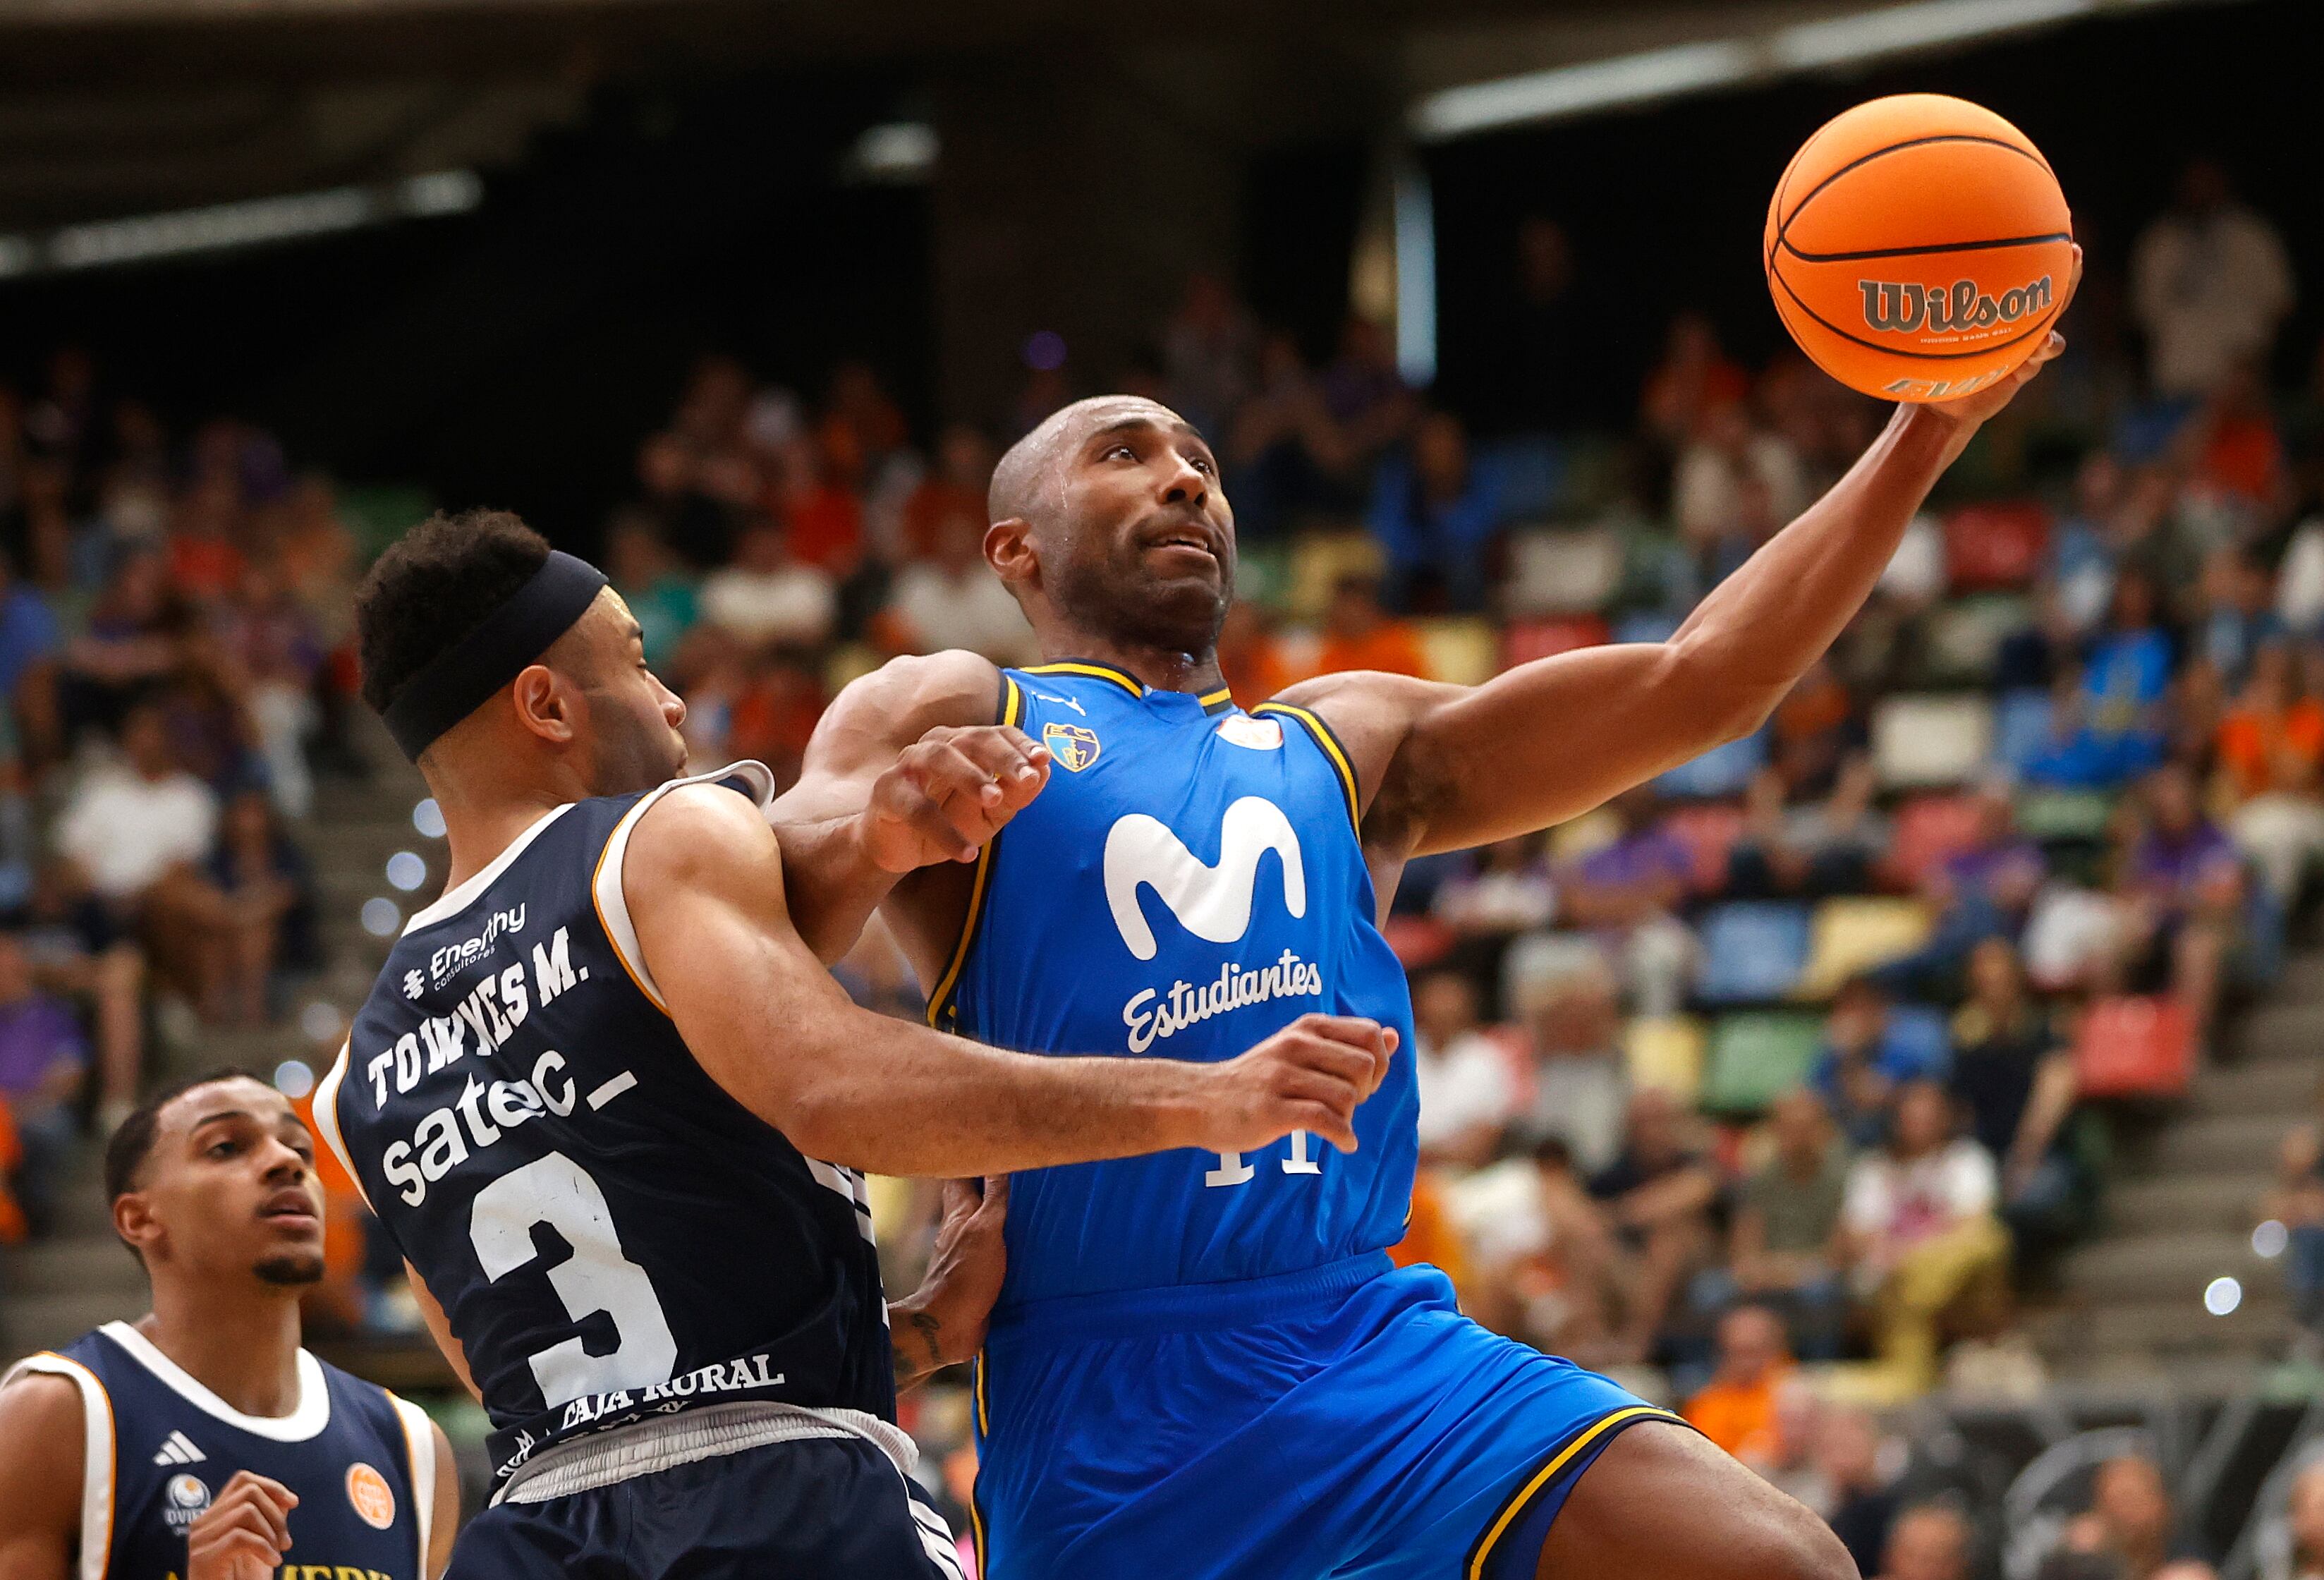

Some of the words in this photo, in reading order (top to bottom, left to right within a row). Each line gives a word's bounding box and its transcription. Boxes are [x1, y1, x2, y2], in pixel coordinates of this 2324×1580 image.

[1858, 275, 2052, 333] Wilson
[430, 902, 525, 980] Enerthy
[434, 944, 496, 992] consultores
[533, 925, 590, 1008] M.
[1123, 948, 1322, 1053] Estudiantes
[470, 1150, 678, 1410] 3
